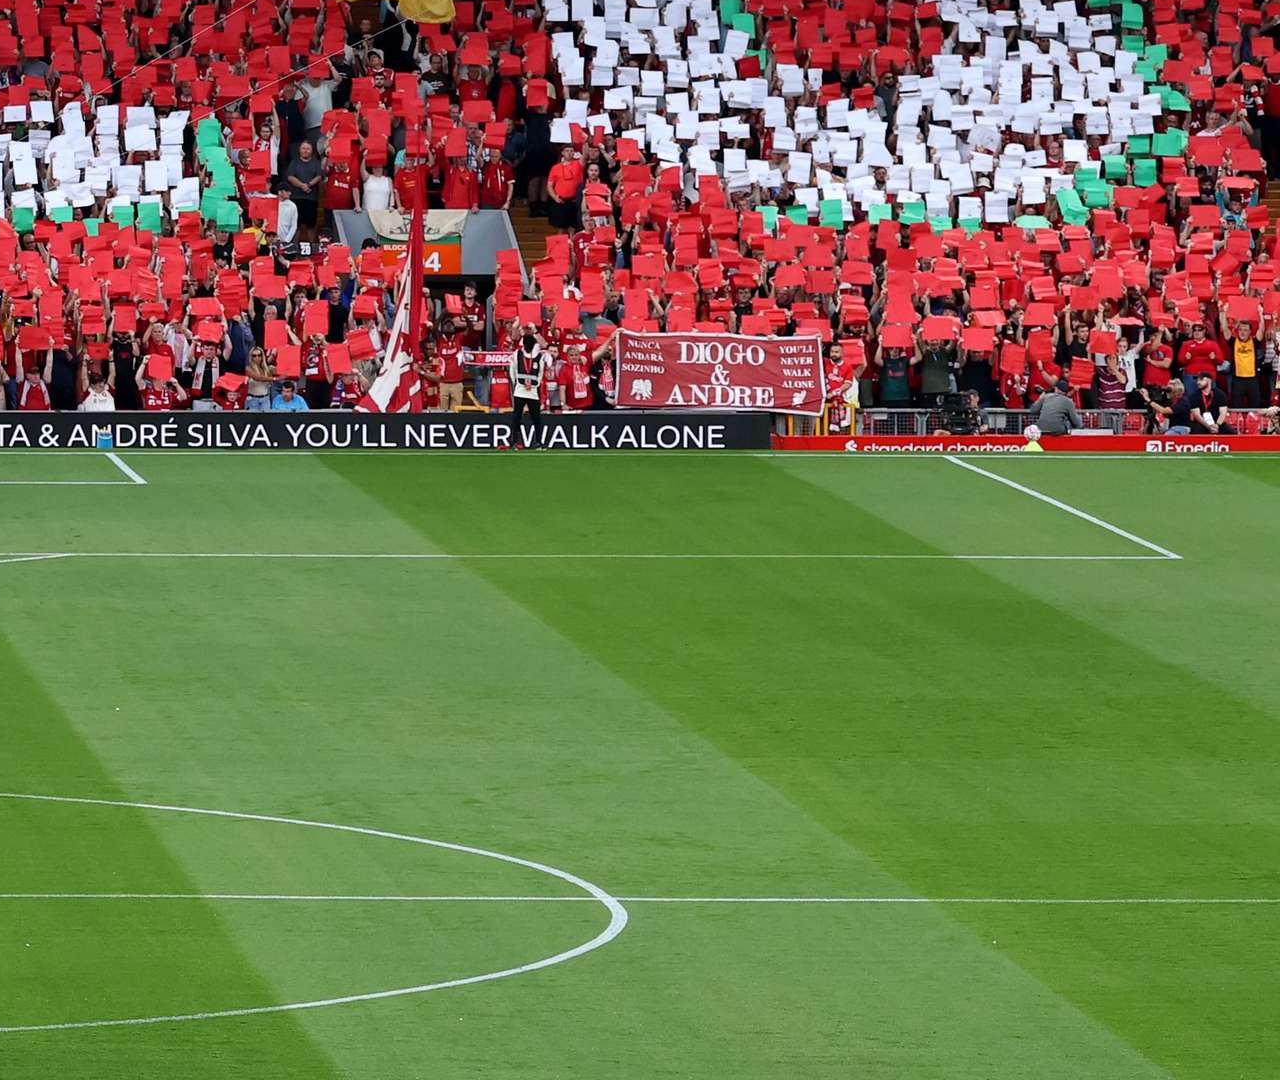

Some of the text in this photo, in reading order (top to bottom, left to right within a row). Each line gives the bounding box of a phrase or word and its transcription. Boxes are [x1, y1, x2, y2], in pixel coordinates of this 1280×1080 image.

[300, 242, 311, 255] 20
[627, 339, 661, 350] NUNCA
[779, 345, 815, 354] YOU'LL
[624, 351, 664, 362] ANDARÁ
[677, 341, 766, 366] DIOGO
[781, 357, 814, 365] NEVER
[622, 363, 665, 374] SOZINHO
[783, 368, 812, 377] WALK
[710, 364, 730, 386] &
[783, 380, 815, 389] ALONE
[665, 384, 775, 407] ANDRE
[39, 424, 60, 448] &
[188, 424, 278, 448] SILVA.
[285, 424, 397, 448] YOU'LL
[406, 424, 511, 448] NEVER
[521, 424, 610, 448] WALK
[617, 424, 725, 449] ALONE
[864, 441, 1028, 452] standard chartere
[1165, 441, 1230, 452] Expedia
